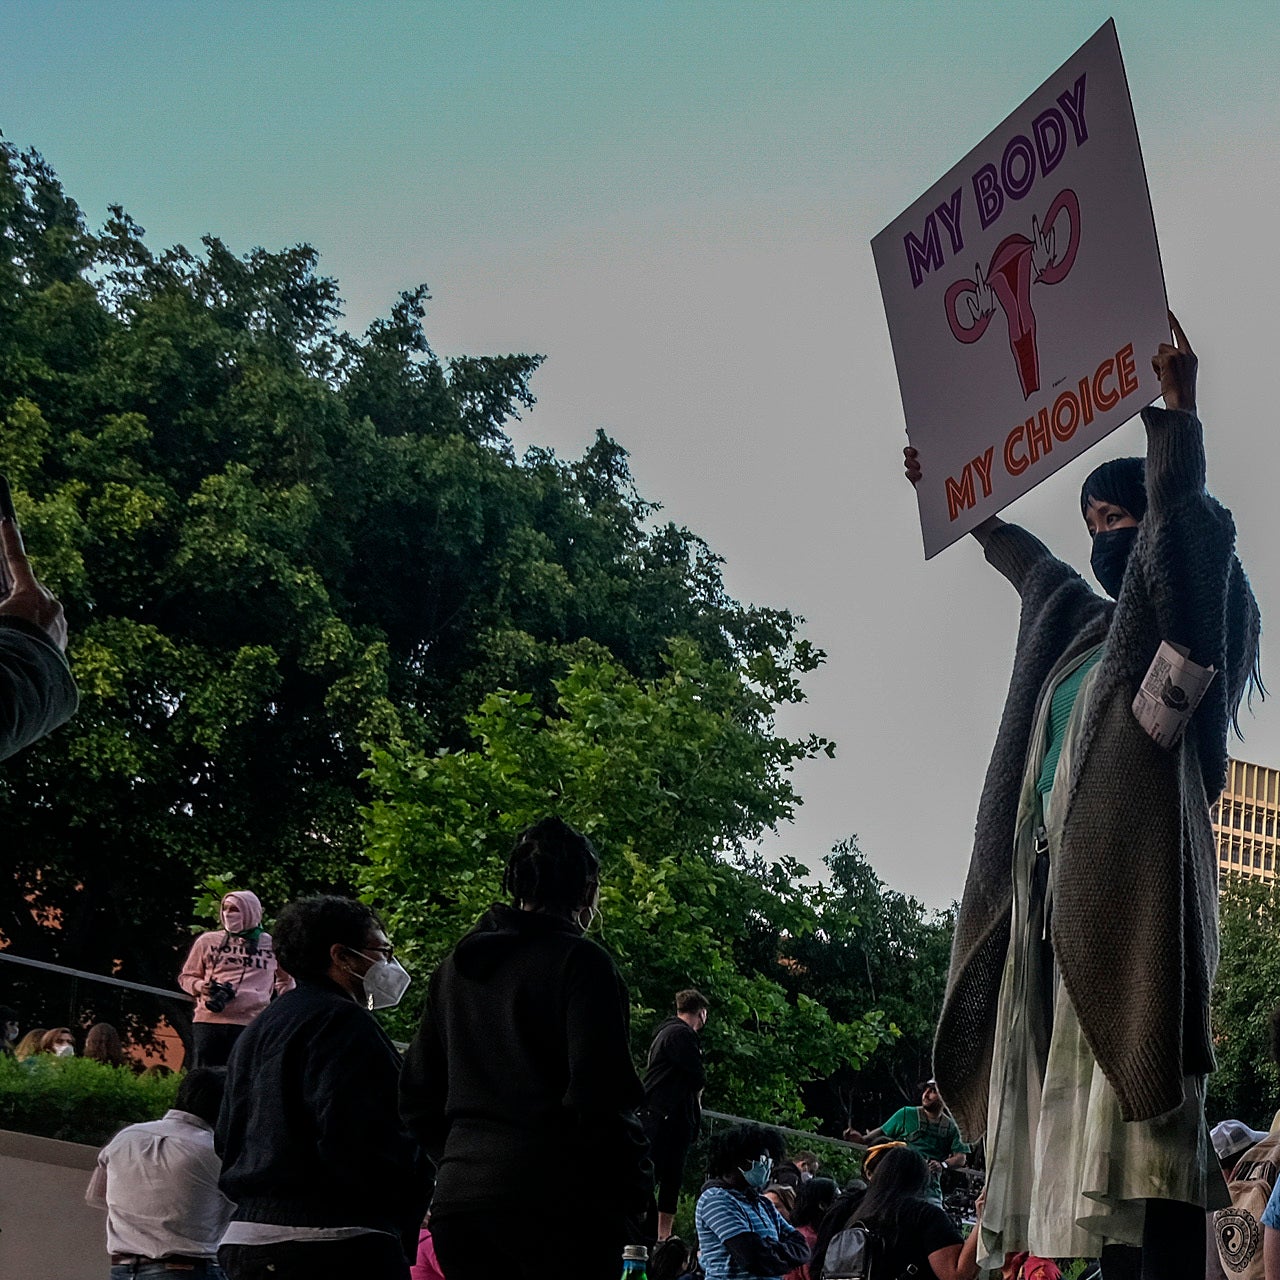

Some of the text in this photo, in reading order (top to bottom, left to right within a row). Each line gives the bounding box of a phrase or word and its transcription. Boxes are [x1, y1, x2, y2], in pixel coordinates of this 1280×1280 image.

[903, 72, 1090, 288] MY BODY
[944, 342, 1140, 521] MY CHOICE
